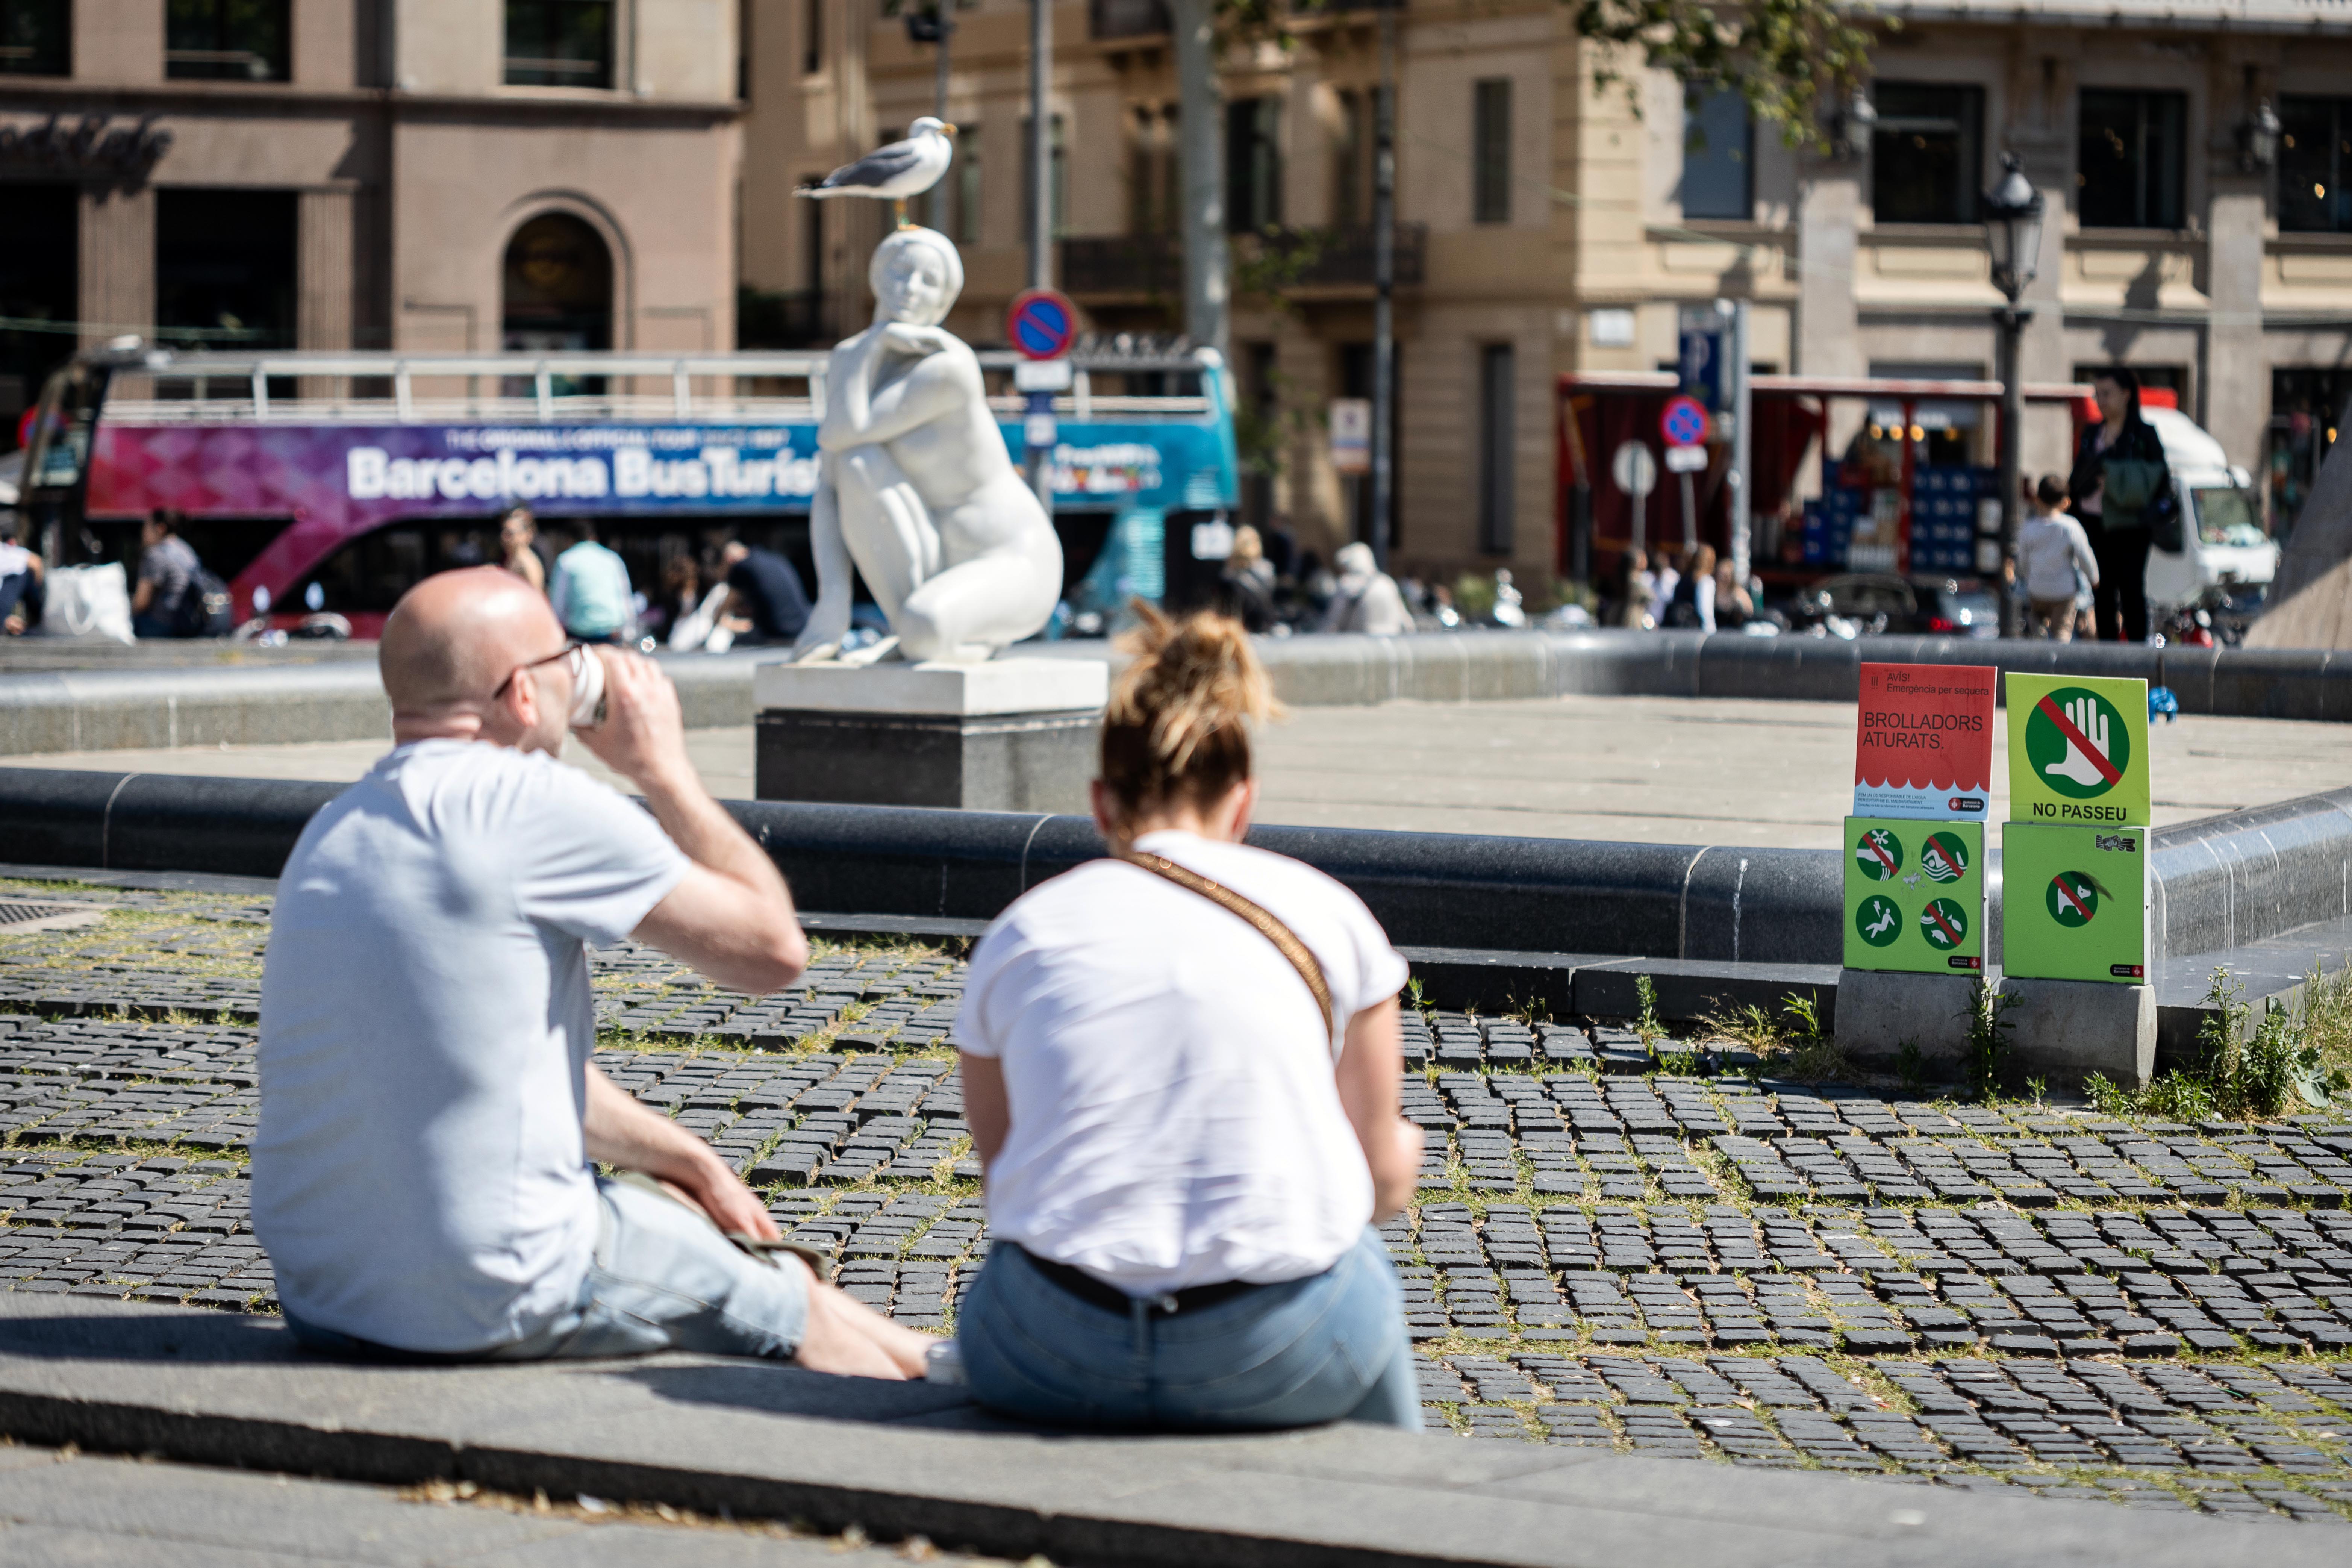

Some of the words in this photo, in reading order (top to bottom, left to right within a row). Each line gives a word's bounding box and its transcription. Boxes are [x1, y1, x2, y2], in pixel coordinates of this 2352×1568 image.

[348, 447, 609, 499] Barcelona
[614, 447, 821, 497] BusTurís
[1887, 671, 1910, 682] AVÍS!
[1887, 683, 1936, 695] Emergència
[1939, 687, 1952, 695] per
[1955, 687, 1989, 697] sequera
[1864, 712, 1982, 731] BROLLADORS
[1863, 731, 1944, 749] ATURATS.
[2033, 803, 2057, 817] NO
[2062, 804, 2126, 821] PASSEU
